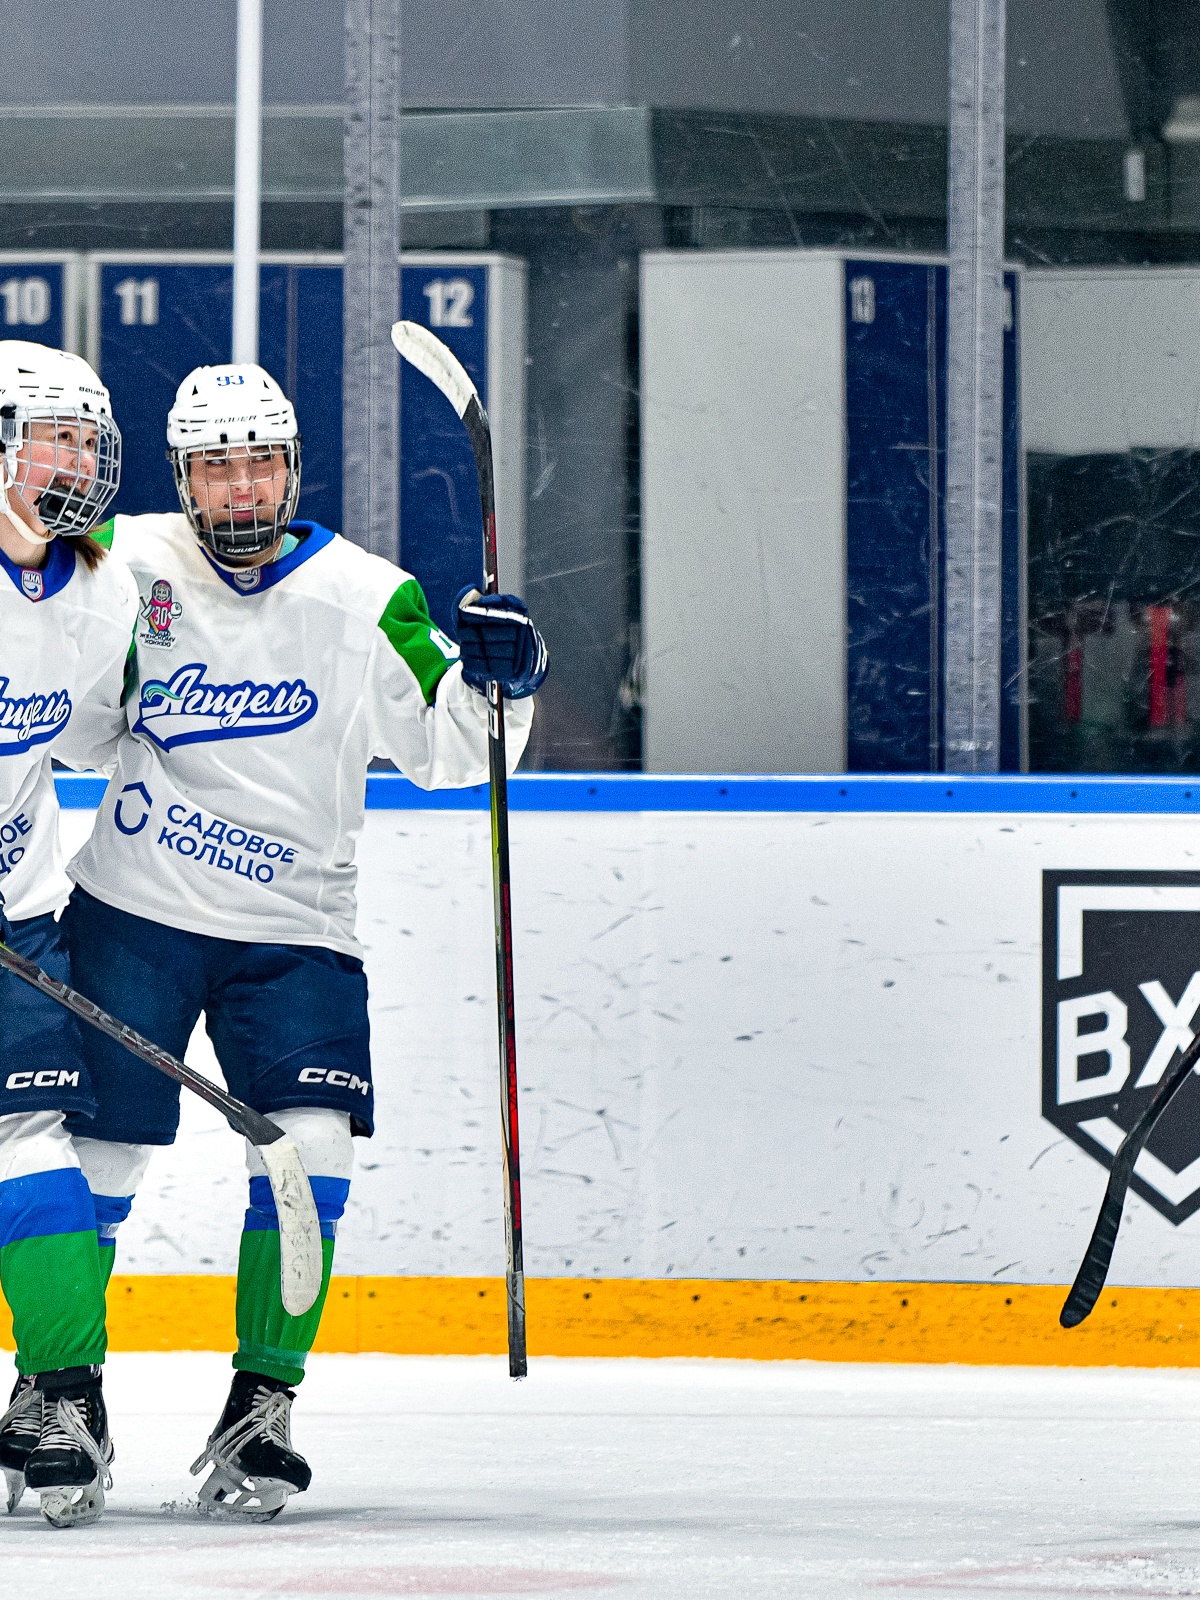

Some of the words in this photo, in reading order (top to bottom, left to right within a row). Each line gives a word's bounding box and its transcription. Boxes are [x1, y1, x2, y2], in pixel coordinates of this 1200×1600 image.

[0, 277, 50, 326] 10
[116, 277, 159, 326] 11
[423, 278, 474, 327] 12
[157, 826, 275, 884] КОЛЬЦО
[166, 804, 299, 864] САДОВОЕ
[5, 1070, 80, 1090] CCM
[297, 1067, 370, 1096] CCM
